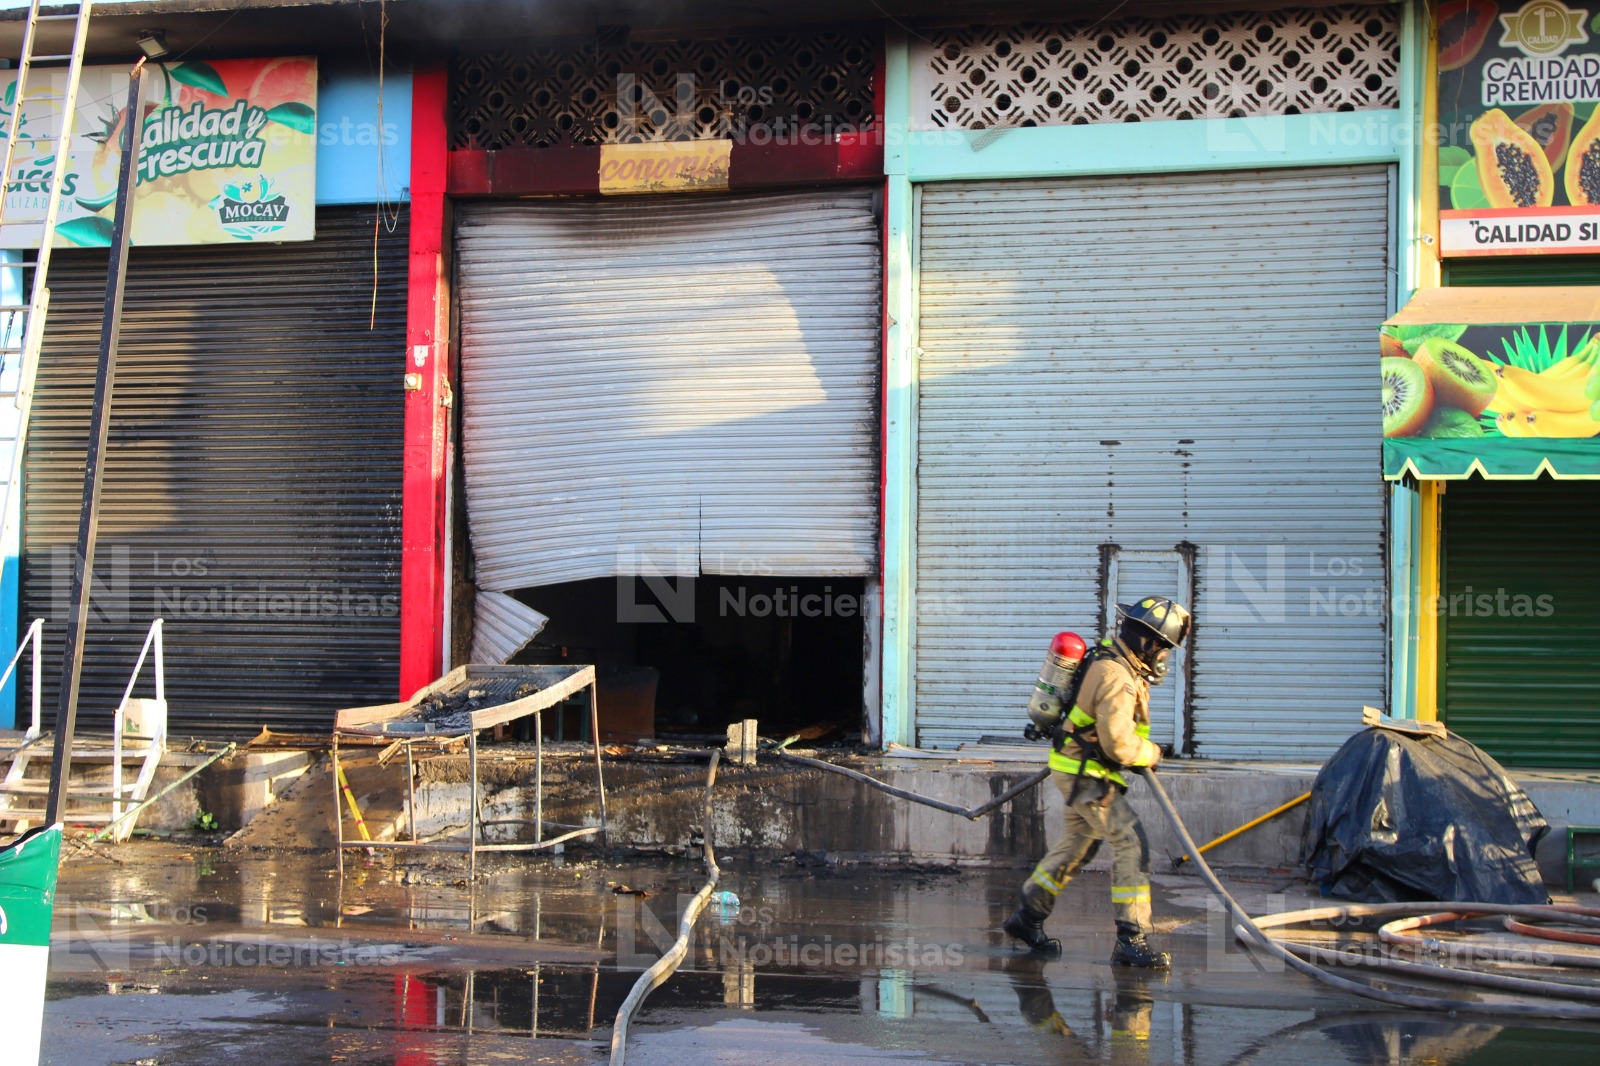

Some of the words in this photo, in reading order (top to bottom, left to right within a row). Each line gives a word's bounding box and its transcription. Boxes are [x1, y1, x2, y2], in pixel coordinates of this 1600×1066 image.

[1527, 35, 1559, 44] CALIDAD
[1487, 58, 1600, 82] CALIDAD
[1487, 79, 1600, 103] PREMIUM
[121, 102, 245, 150] alidad
[245, 108, 266, 140] y
[600, 146, 729, 182] conomi
[225, 203, 285, 219] MOCAV
